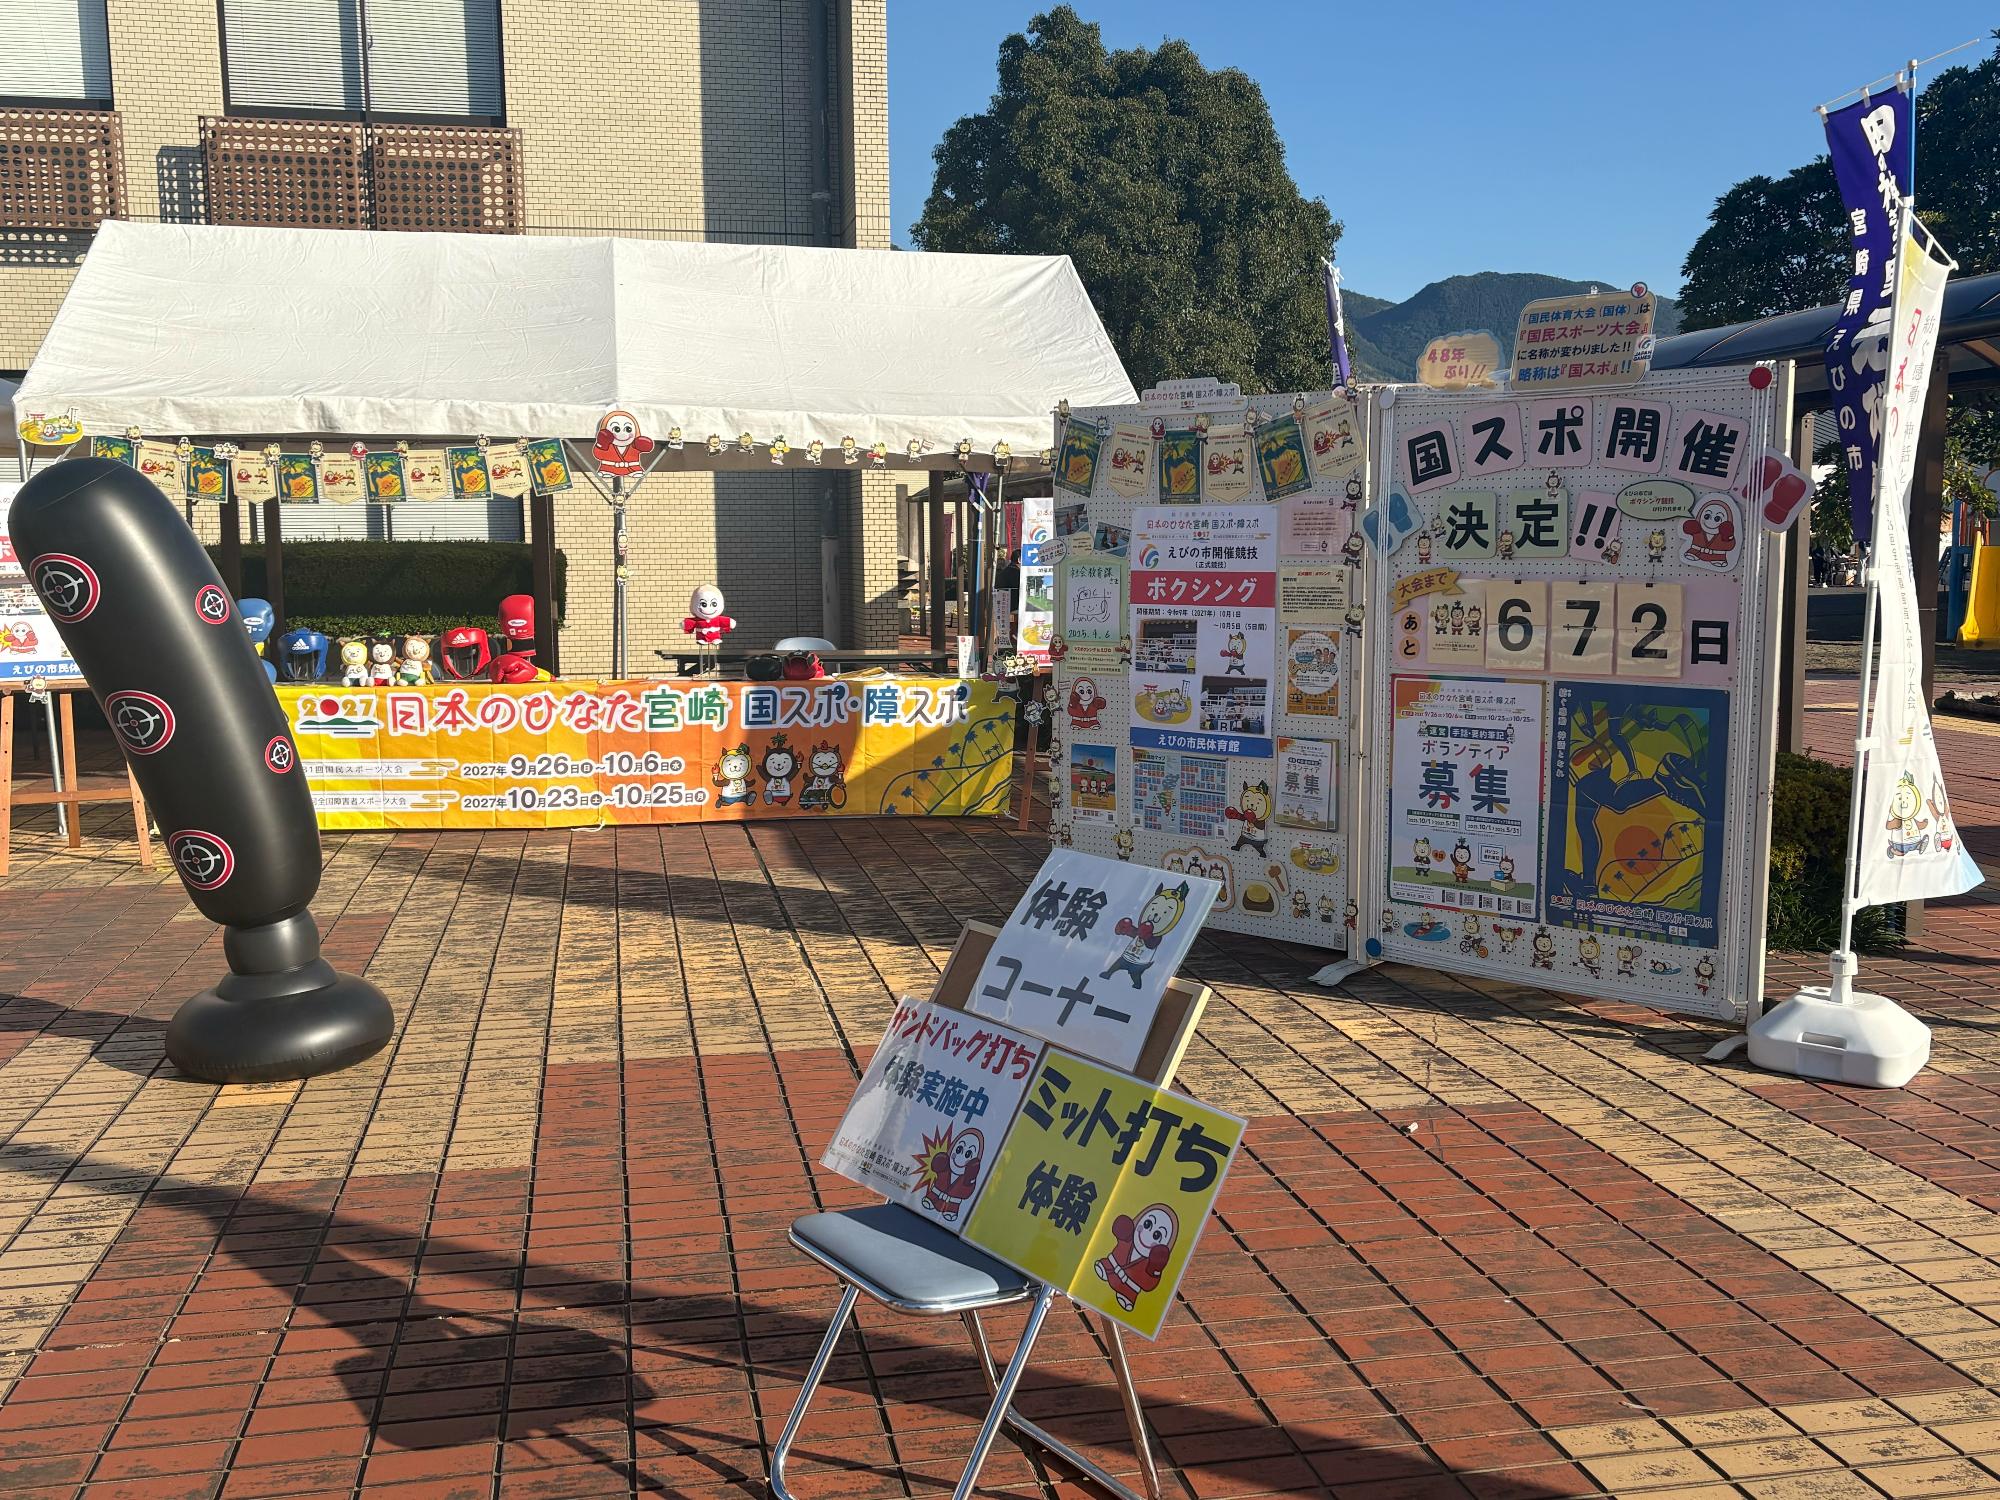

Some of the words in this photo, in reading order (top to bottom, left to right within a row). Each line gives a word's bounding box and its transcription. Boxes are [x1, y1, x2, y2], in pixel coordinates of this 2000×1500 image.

[1519, 320, 1649, 344] 『国民スポーツ大会』
[1427, 347, 1467, 364] 48年
[1144, 391, 1194, 401] 日本のひなた宮崎
[1408, 405, 1739, 487] 国スポ開催
[1146, 519, 1209, 530] 日本のひなた宮崎
[1211, 518, 1260, 529] 国スポ・障スポ
[1168, 546, 1259, 560] えびの市開催競技
[1070, 567, 1113, 578] 社会教育課
[1398, 572, 1448, 598] 大会まで
[1146, 576, 1259, 604] ボクシング
[1403, 614, 1418, 656] あと
[390, 686, 729, 733] 日本のひなた宮崎
[743, 684, 970, 728] 国スポ・障スポ
[1418, 692, 1473, 703] 日本のひなた宮崎
[1474, 695, 1516, 705] 国スポ・障スポ
[1157, 734, 1241, 753] えびの市民体育館
[1421, 740, 1510, 761] ボランティア
[1284, 771, 1320, 795] 募集
[1418, 759, 1511, 814] 募集
[1019, 878, 1108, 942] 体験
[1576, 899, 1654, 921] 日本のひなた宮崎
[1655, 910, 1713, 929] 国スポ・障スポ
[982, 955, 1132, 1028] コーナー
[892, 1005, 1037, 1080] サンドバッグ打ち
[877, 1054, 990, 1124] 体験実施中
[1022, 1065, 1232, 1193] ミット打ち
[1017, 1159, 1099, 1237] 体験
